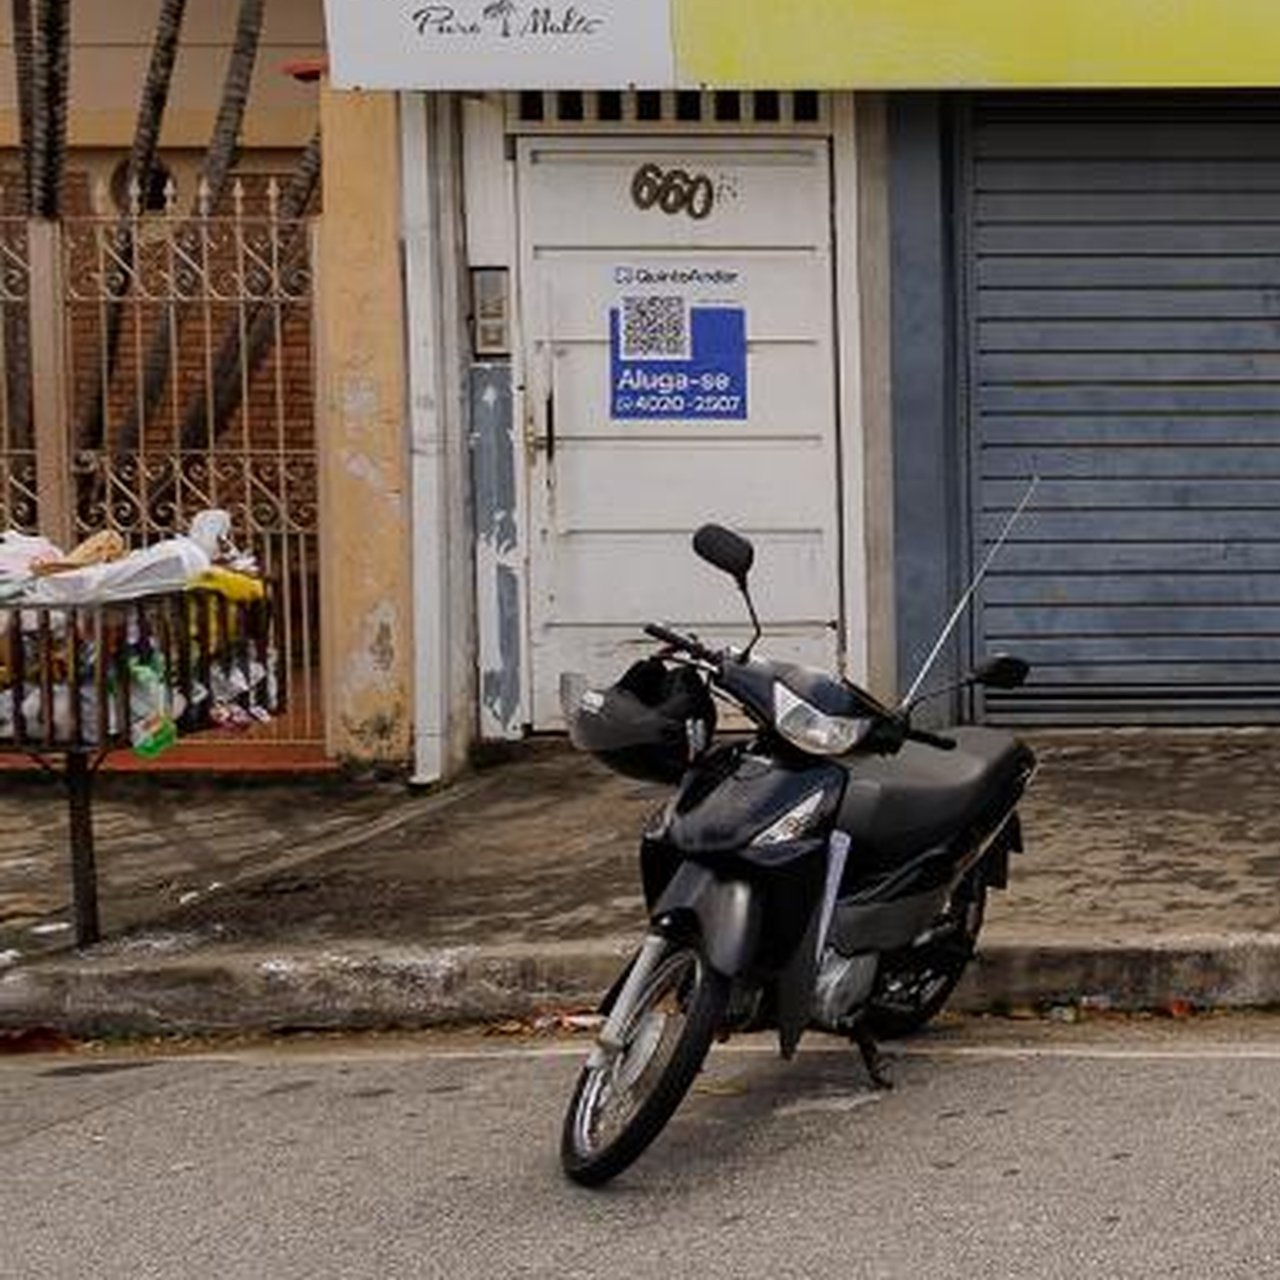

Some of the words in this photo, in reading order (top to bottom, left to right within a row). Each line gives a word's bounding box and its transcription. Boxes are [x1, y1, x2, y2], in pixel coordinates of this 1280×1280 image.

[631, 162, 714, 219] 660
[636, 268, 739, 284] QuintoAndar
[618, 369, 730, 394] Aluga-se
